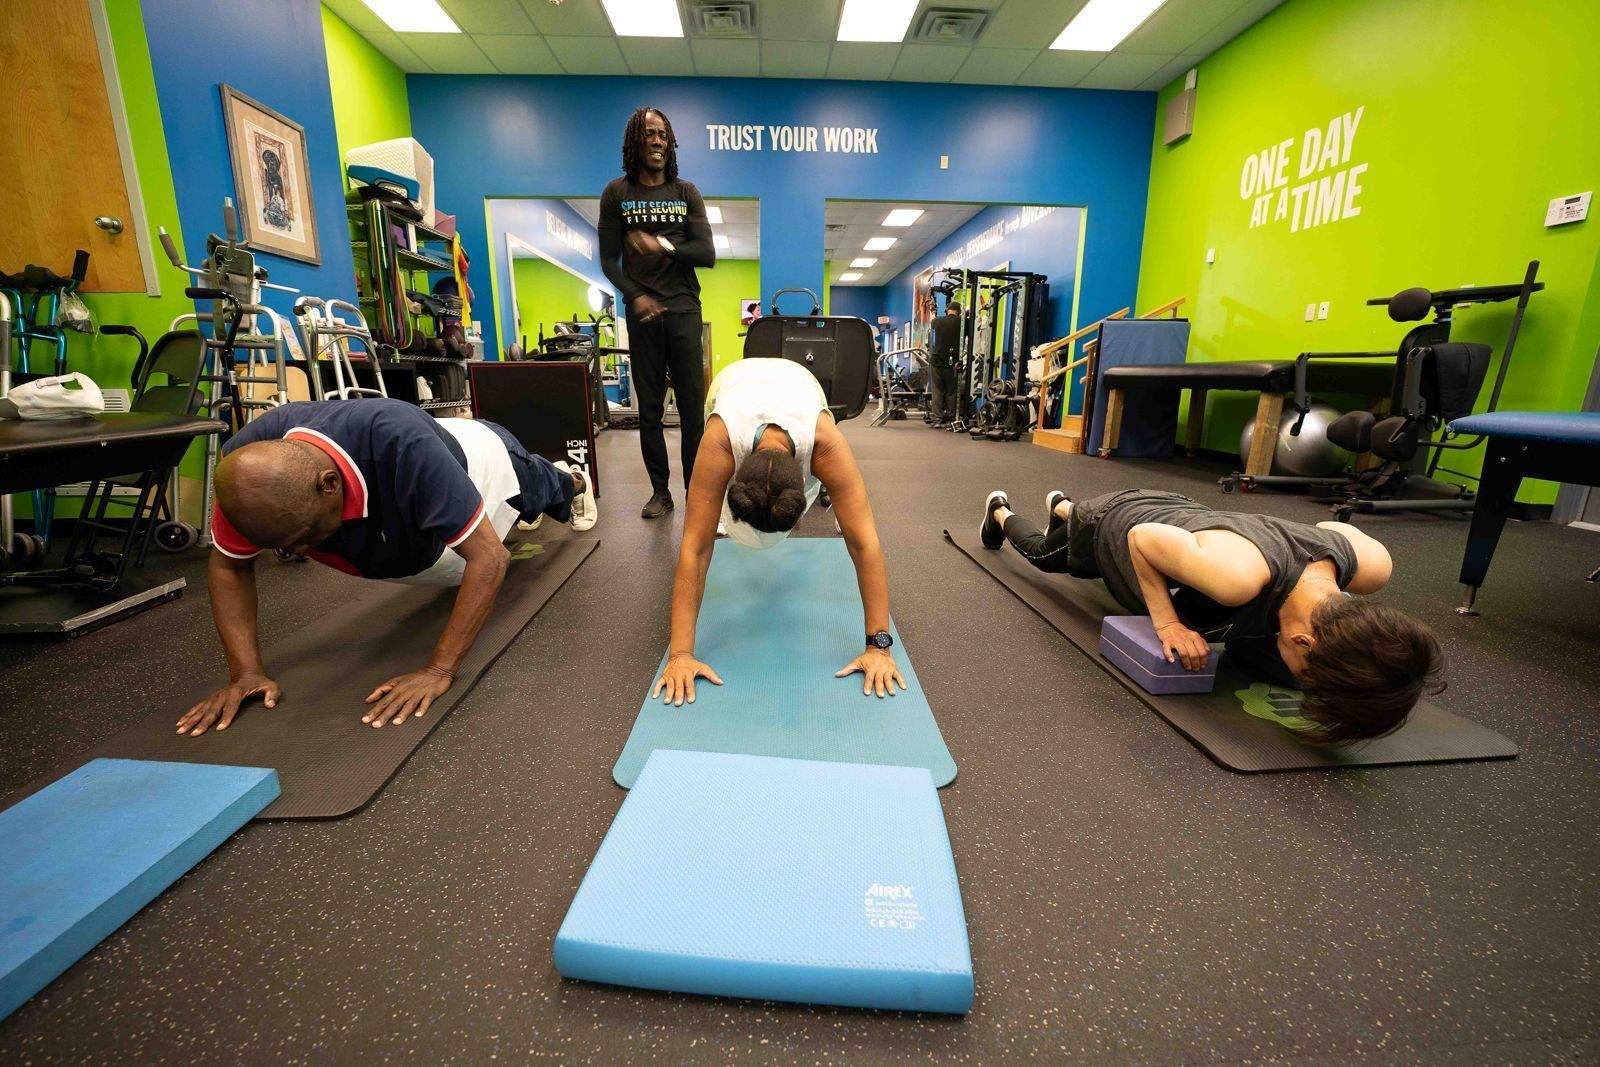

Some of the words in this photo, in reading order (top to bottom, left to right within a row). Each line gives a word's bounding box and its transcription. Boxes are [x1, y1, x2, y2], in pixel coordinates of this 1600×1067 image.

[706, 124, 765, 151] TRUST
[769, 126, 818, 152] YOUR
[823, 127, 879, 154] WORK
[1240, 137, 1294, 200] ONE
[1298, 105, 1365, 180] DAY
[621, 201, 647, 216] SPLIT
[649, 201, 688, 216] SECOND
[1249, 192, 1274, 229] AT
[1274, 186, 1289, 222] A
[1290, 162, 1369, 233] TIME
[627, 215, 683, 224] FITNESS
